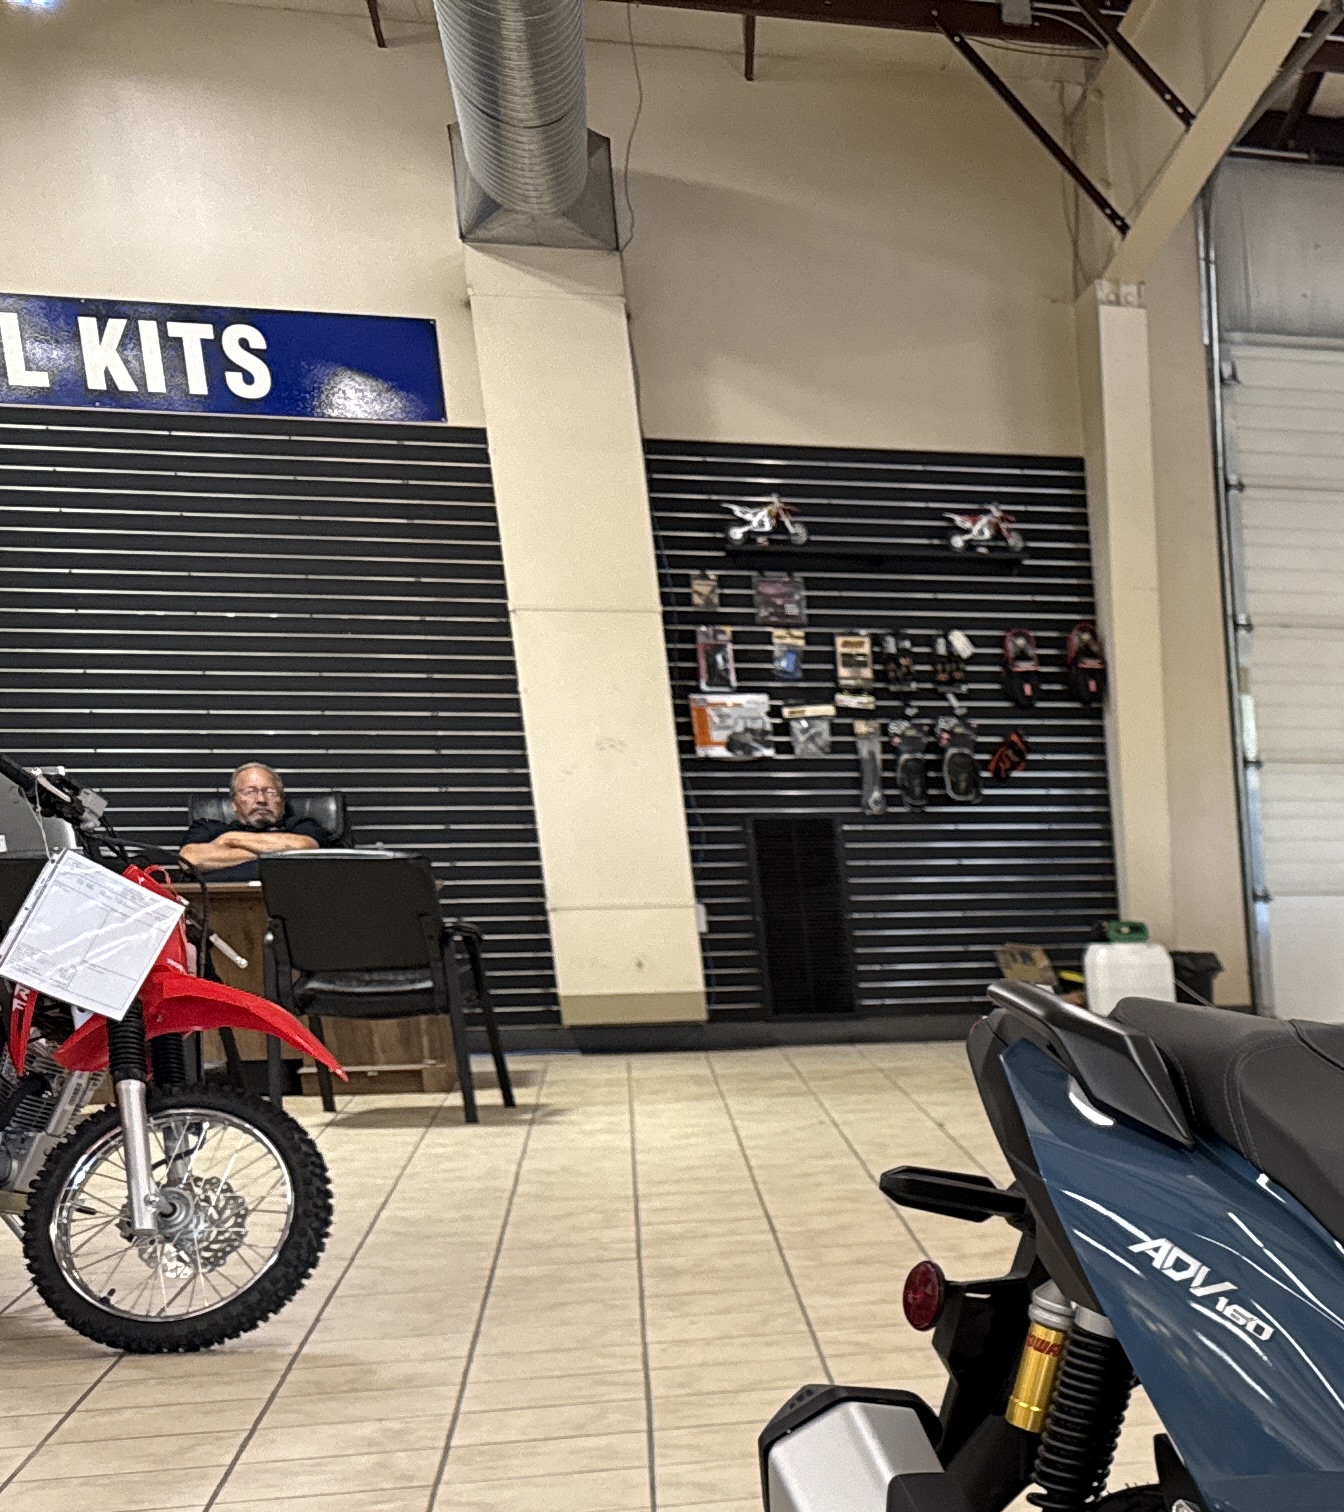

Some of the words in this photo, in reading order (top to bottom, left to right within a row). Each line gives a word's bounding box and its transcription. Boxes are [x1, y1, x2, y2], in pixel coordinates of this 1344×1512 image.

[77, 315, 272, 400] KITS
[1127, 1237, 1239, 1297] ADV
[1215, 1296, 1276, 1341] 160
